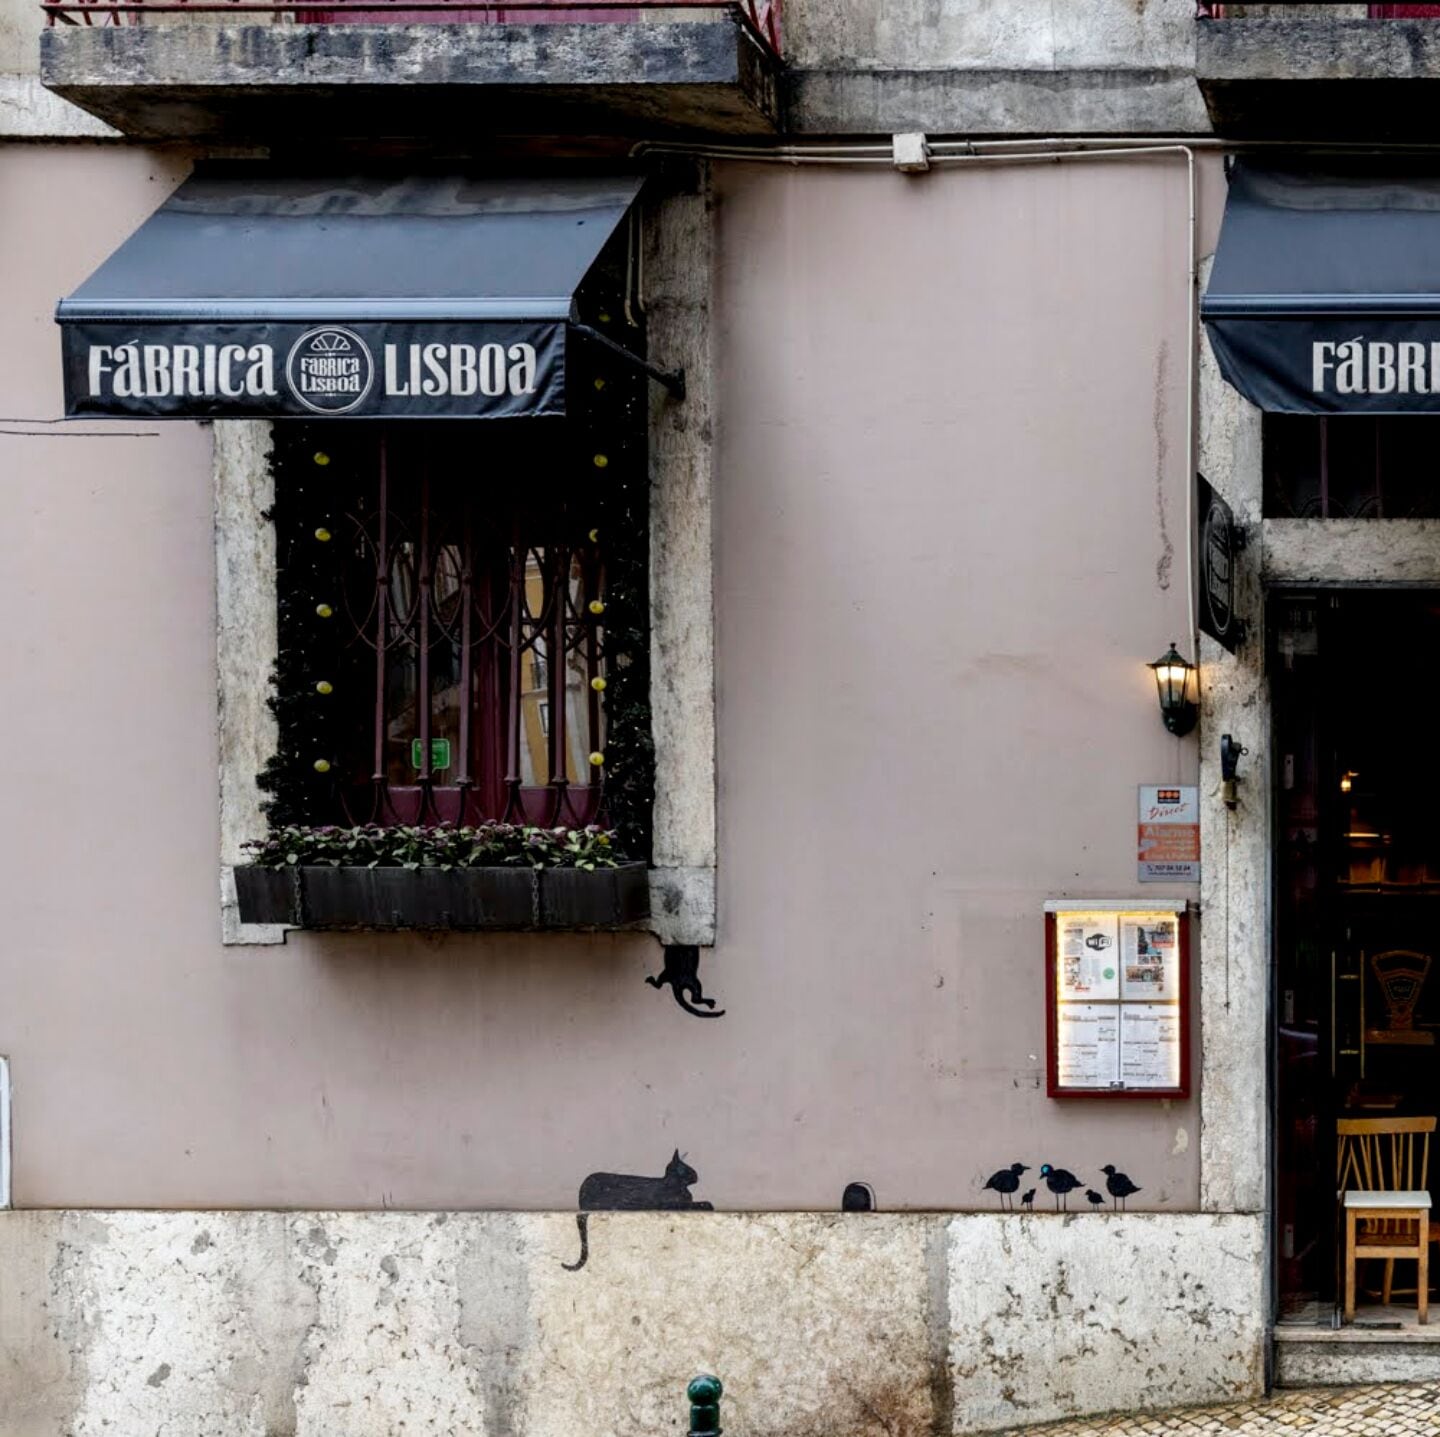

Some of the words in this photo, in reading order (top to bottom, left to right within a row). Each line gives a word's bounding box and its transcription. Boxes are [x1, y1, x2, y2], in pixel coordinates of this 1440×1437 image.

[88, 338, 278, 398] FÁBRICA
[384, 342, 536, 397] LISBOA
[301, 373, 361, 392] LISBOA
